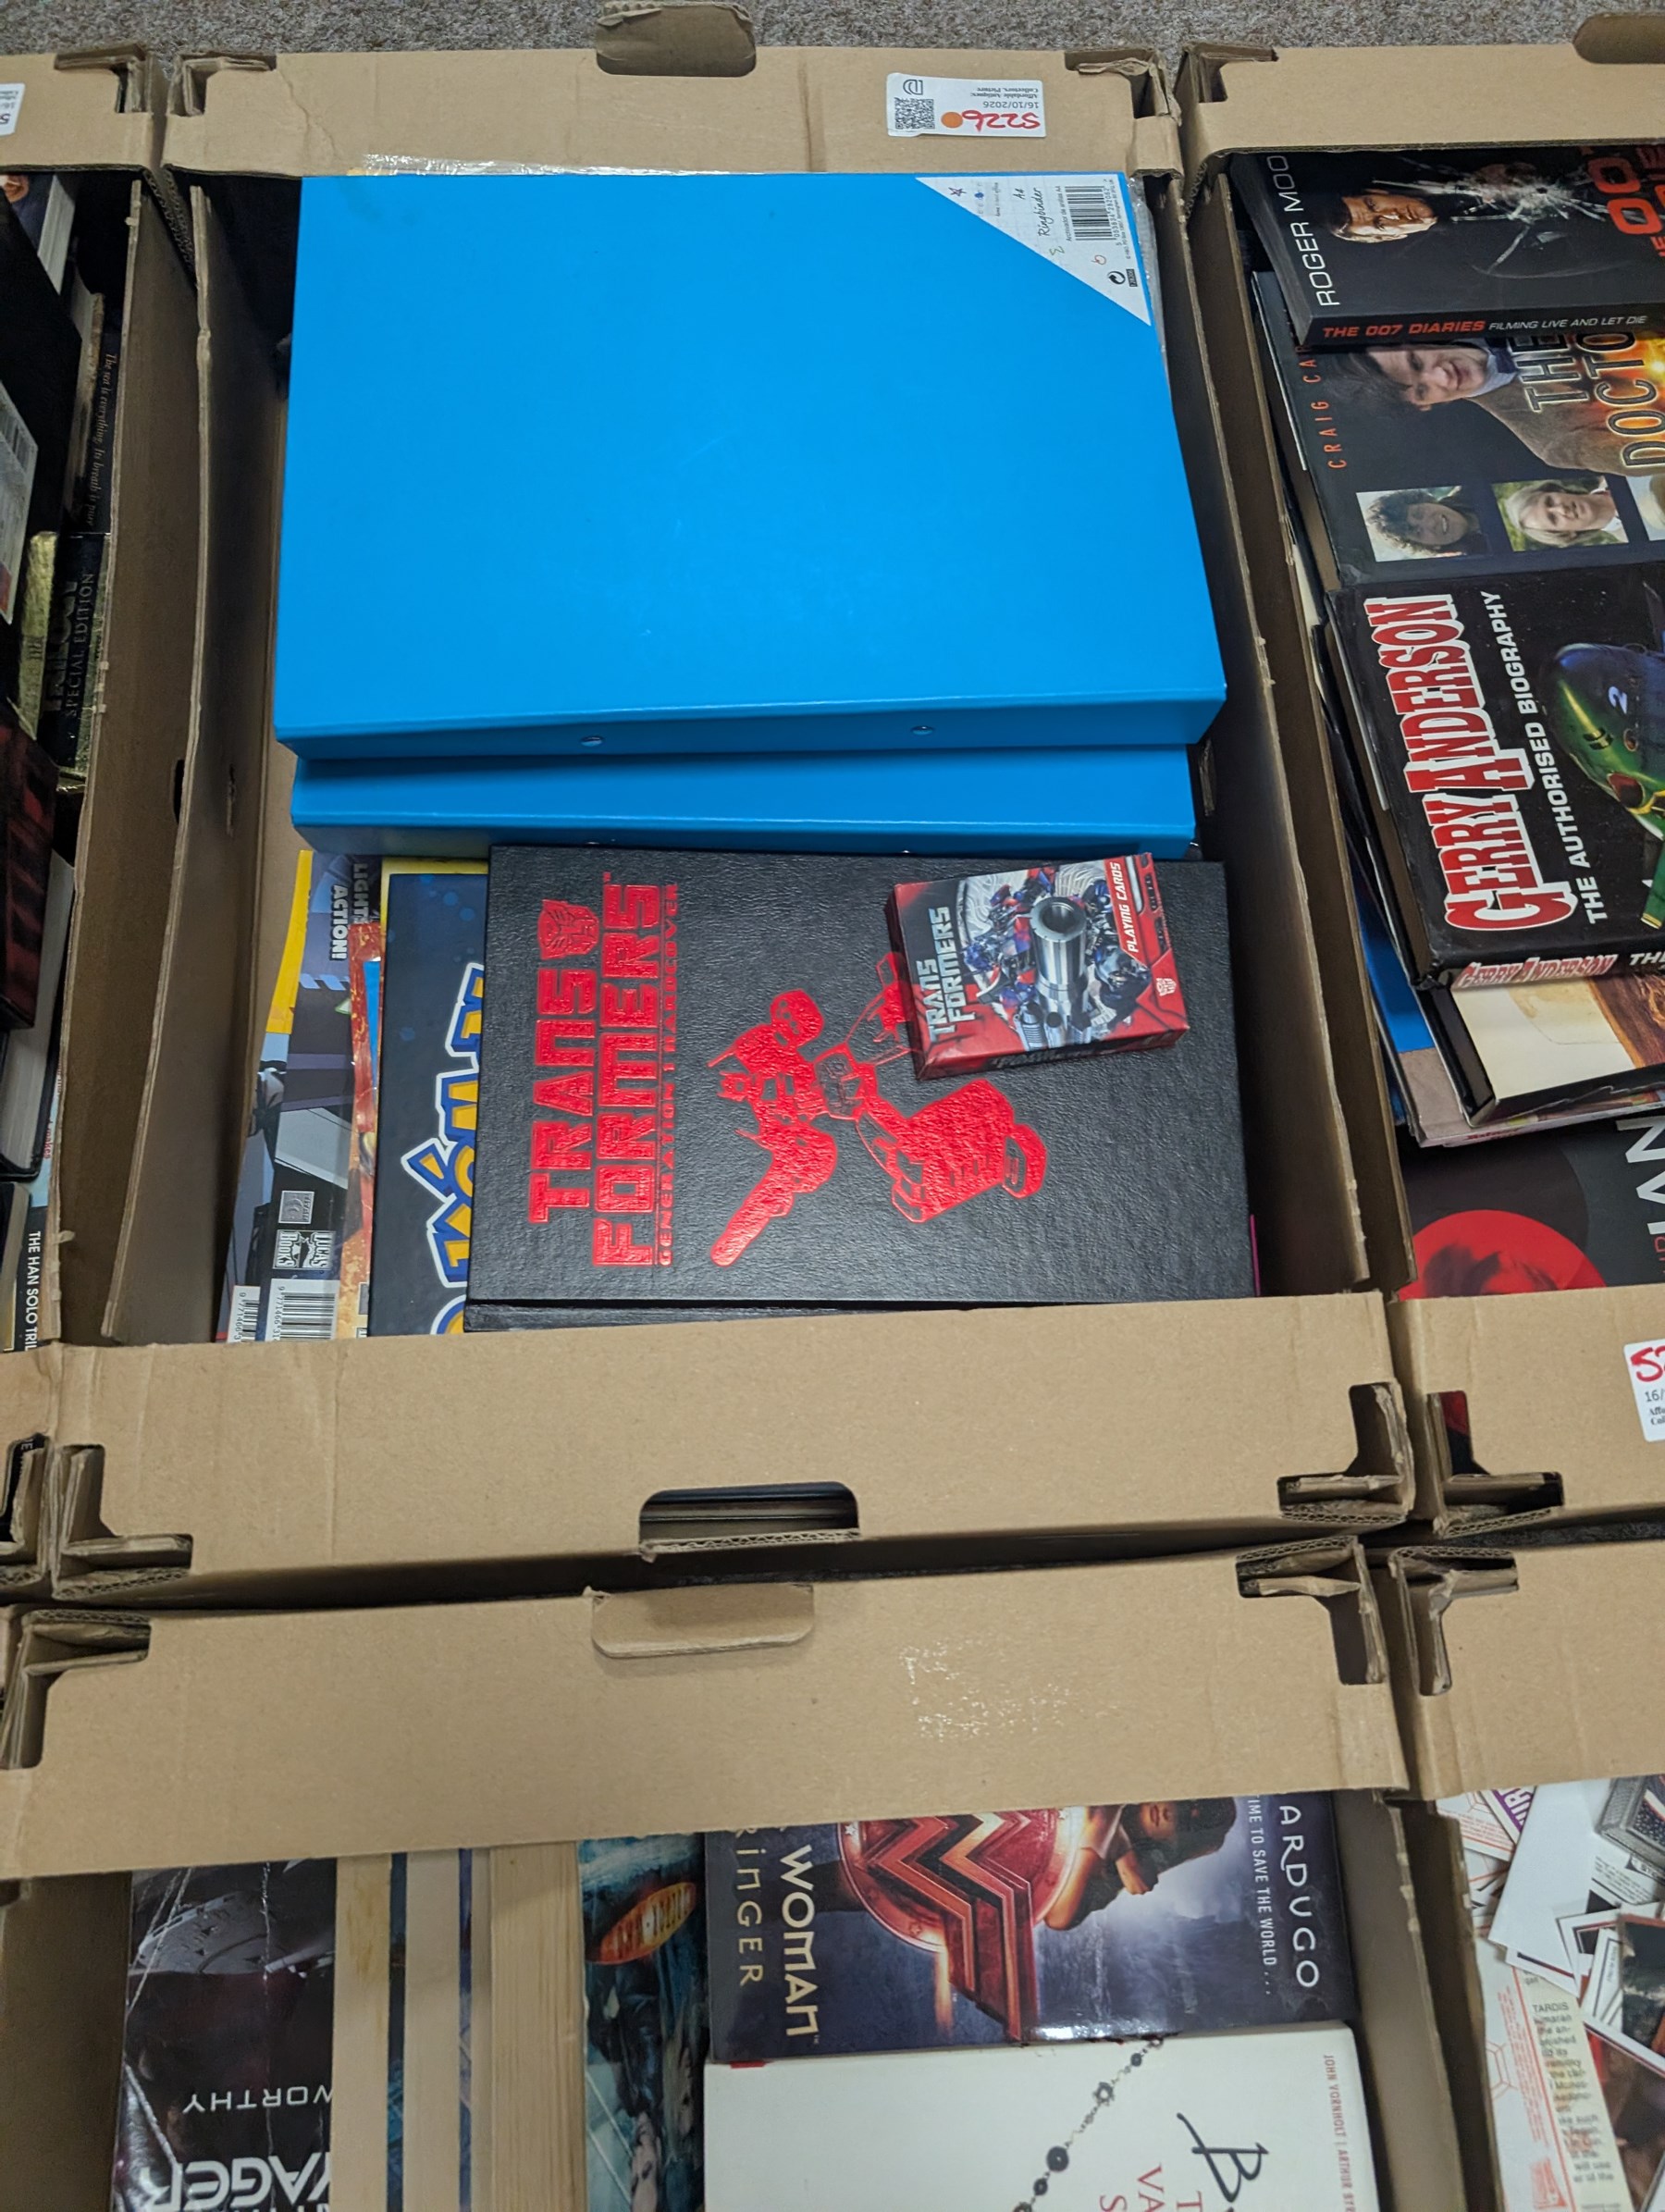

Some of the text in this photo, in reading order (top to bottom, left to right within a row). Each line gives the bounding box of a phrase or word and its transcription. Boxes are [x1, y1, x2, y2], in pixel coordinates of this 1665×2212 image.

[982, 100, 1039, 109] 16/10/2026
[1016, 189, 1025, 200] A4
[1032, 187, 1054, 237] Ringbinder
[1292, 222, 1339, 306] ROGER
[1323, 315, 1647, 339] THE 007 DIARIES FILMING LIVE AND LET DIE
[1505, 334, 1590, 412] THE
[1310, 401, 1347, 469] CRAIG
[66, 573, 94, 718] SPECIAL EDITION
[1364, 593, 1578, 931] GERRY ANDERSON
[1480, 590, 1608, 924] THE AUTHORISED BIOGRAPHY
[331, 884, 348, 960] ACTION!
[1110, 862, 1140, 954] PLAYING CARDS
[662, 884, 679, 1055] HARDCOVER
[928, 907, 977, 1025] FORMERS
[916, 958, 956, 1044] TRANS
[528, 968, 598, 1224] TRANS
[592, 884, 660, 1267] FORMERS
[657, 1081, 675, 1267] GENERATION
[27, 1231, 42, 1253] THE
[27, 1256, 41, 1285] HAN
[277, 1232, 298, 1267] BOOKS
[311, 1232, 333, 1267] LUCAS
[25, 1289, 38, 1323] SOLO
[1251, 1827, 1265, 1845] TO
[1252, 1849, 1269, 1883] SAVE
[1256, 1887, 1273, 1913] THE
[1279, 1805, 1319, 1988] ARDUGO
[779, 1843, 820, 2036] WOMAN
[1260, 1918, 1277, 1966] WORLD
[1532, 2000, 1570, 2015] TARDIS
[1323, 2054, 1338, 2082] JOHN
[1327, 2083, 1347, 2137] VORNHOLT
